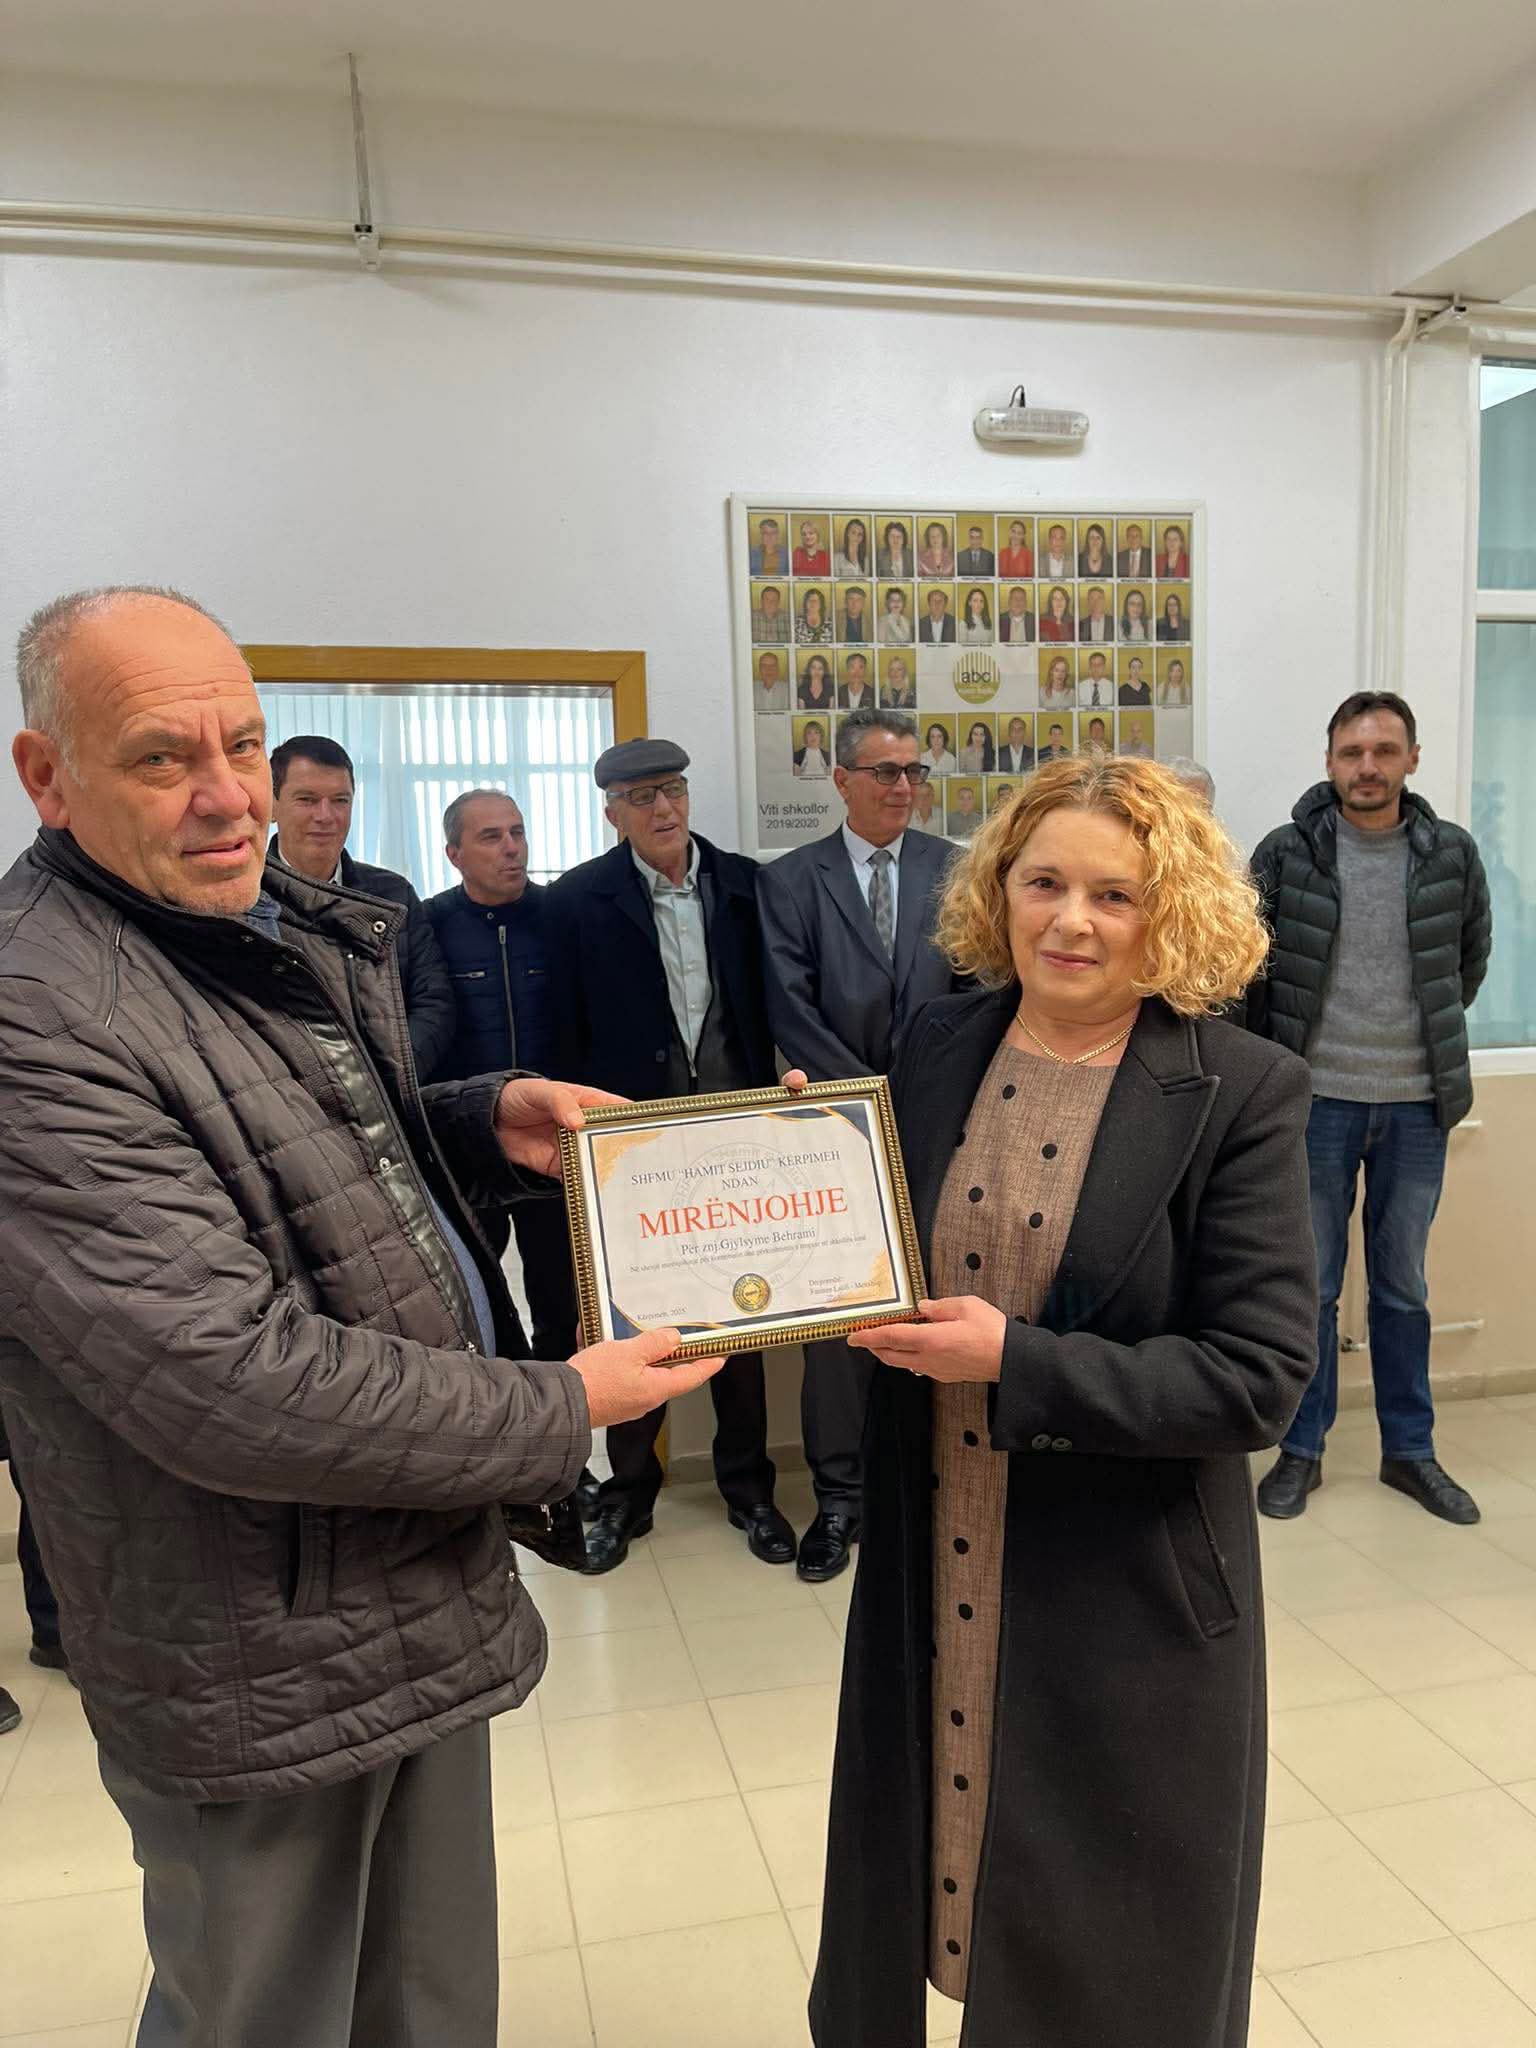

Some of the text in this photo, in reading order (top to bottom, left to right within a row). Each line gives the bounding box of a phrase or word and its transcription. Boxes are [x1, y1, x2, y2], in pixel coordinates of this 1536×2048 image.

[961, 668, 991, 684] abc
[760, 803, 829, 815] Viti shkollor
[767, 818, 820, 829] 2019/2020
[722, 1175, 759, 1190] NDAN
[638, 1187, 849, 1239] MIRËNJOHJE
[772, 1227, 816, 1242] Behrami
